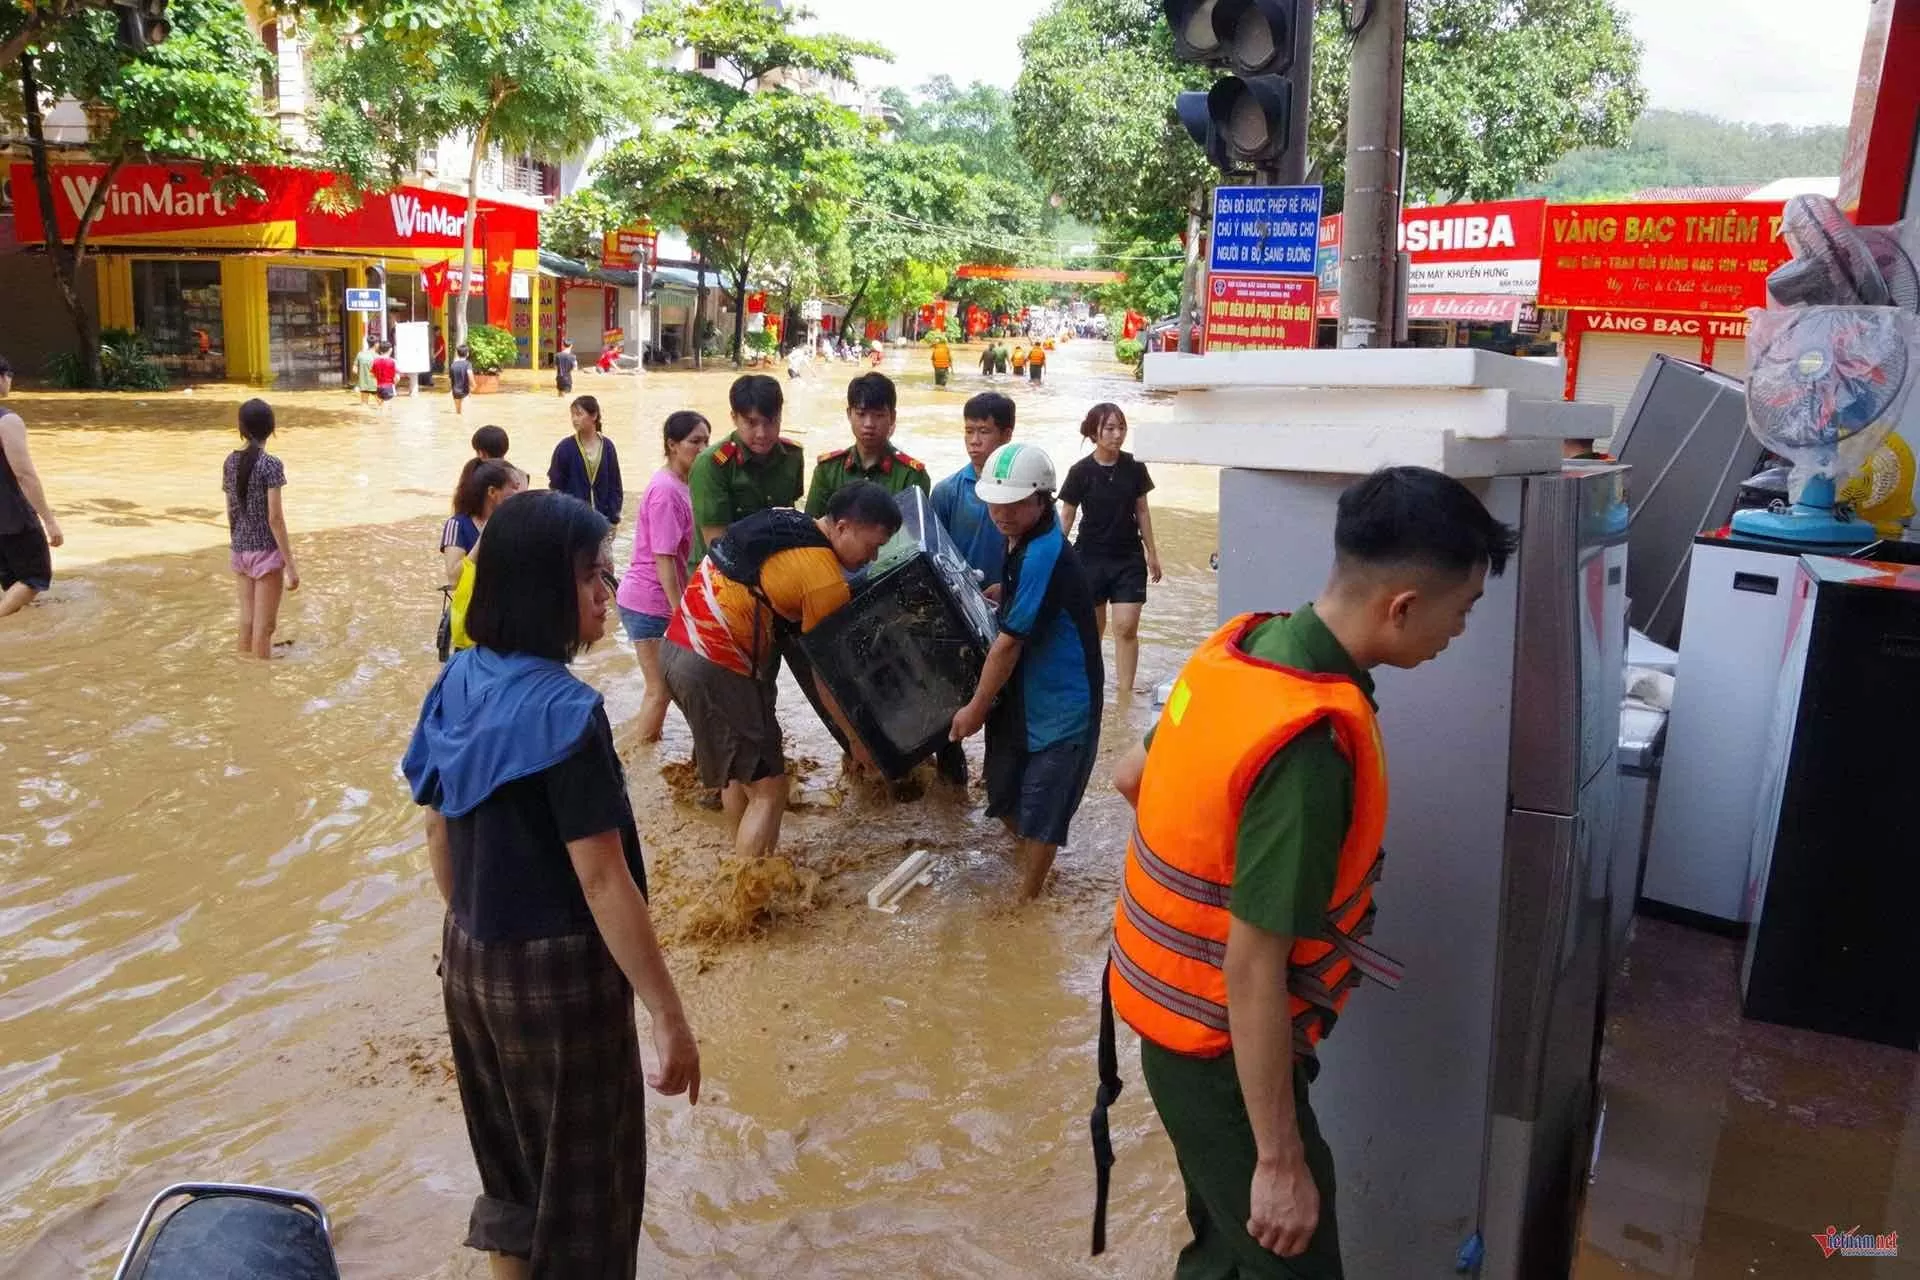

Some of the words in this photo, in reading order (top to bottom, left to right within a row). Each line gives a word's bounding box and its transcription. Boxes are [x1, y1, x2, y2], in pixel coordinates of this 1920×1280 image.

[61, 174, 229, 221] WinMart
[1218, 195, 1233, 214] ĐÈN
[1234, 193, 1245, 214] ĐỎ
[1267, 195, 1288, 214] PHÉP
[1300, 192, 1318, 213] PHẢI
[1217, 218, 1232, 237] CHÚ
[1233, 218, 1240, 237] Ý
[1272, 217, 1297, 237] ĐƯỜNG
[1299, 221, 1315, 237] CHO
[1398, 214, 1516, 251] SHIBA
[1553, 210, 1618, 244] VÀNG
[1624, 215, 1676, 249] BẠC
[1217, 242, 1239, 261] NGƯỜI
[1241, 245, 1249, 261] ĐI
[1264, 246, 1284, 262] SANG
[1286, 242, 1312, 263] ĐƯỜNG
[1427, 268, 1444, 280] MÁY
[1483, 267, 1509, 278] HƯNG
[1587, 313, 1647, 331] VÀNG
[1653, 319, 1700, 337] BẠC
[1708, 319, 1752, 337] THIÊ
